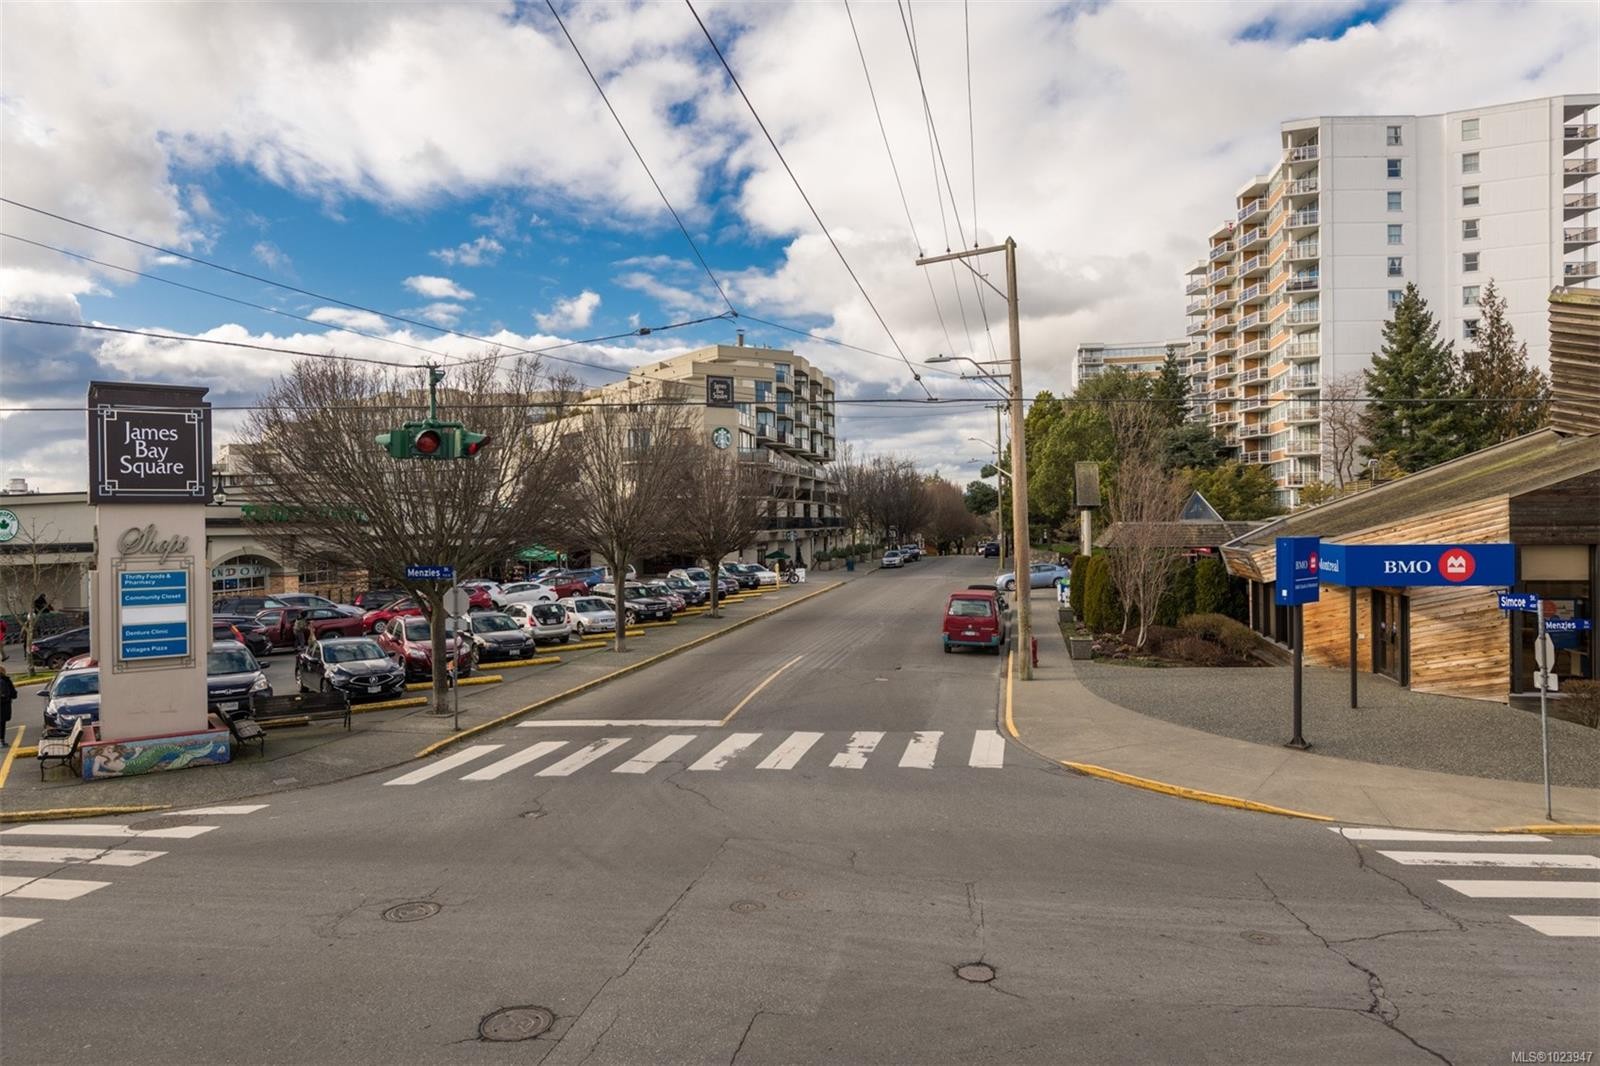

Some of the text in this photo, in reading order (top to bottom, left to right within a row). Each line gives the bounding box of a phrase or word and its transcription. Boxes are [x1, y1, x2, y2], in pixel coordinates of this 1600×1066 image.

[124, 421, 178, 445] James
[135, 440, 168, 463] Bay
[120, 455, 184, 478] Square
[117, 523, 189, 565] Shops
[1295, 560, 1309, 570] BMO
[1383, 560, 1432, 574] BMO
[407, 568, 440, 577] Menzies
[1500, 596, 1526, 607] Simcoe
[1545, 621, 1576, 630] Menzies
[125, 647, 151, 655] Villages
